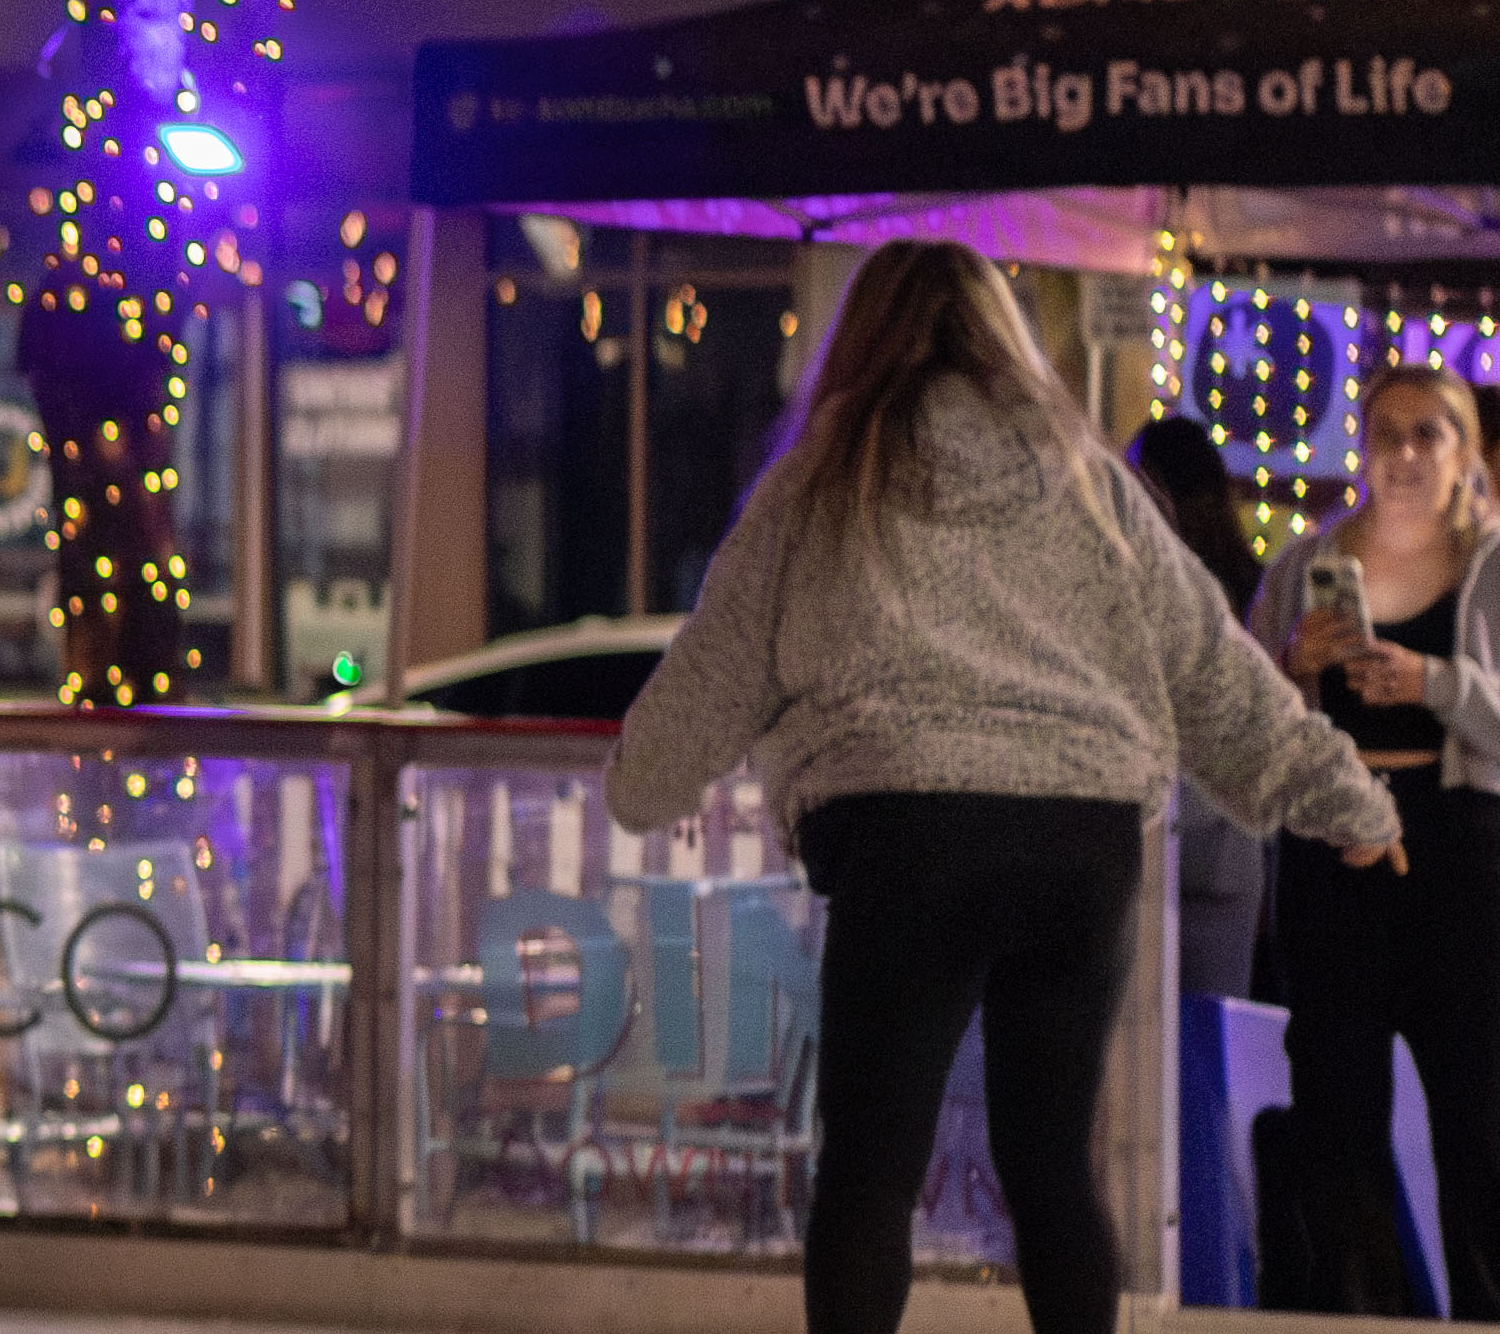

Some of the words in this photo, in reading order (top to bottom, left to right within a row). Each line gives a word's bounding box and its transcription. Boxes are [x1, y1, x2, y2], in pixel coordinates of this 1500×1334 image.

[806, 70, 980, 130] We're
[991, 59, 1094, 134] Big
[1106, 59, 1247, 117] Fans
[1257, 56, 1324, 117] of
[1334, 54, 1453, 116] Life
